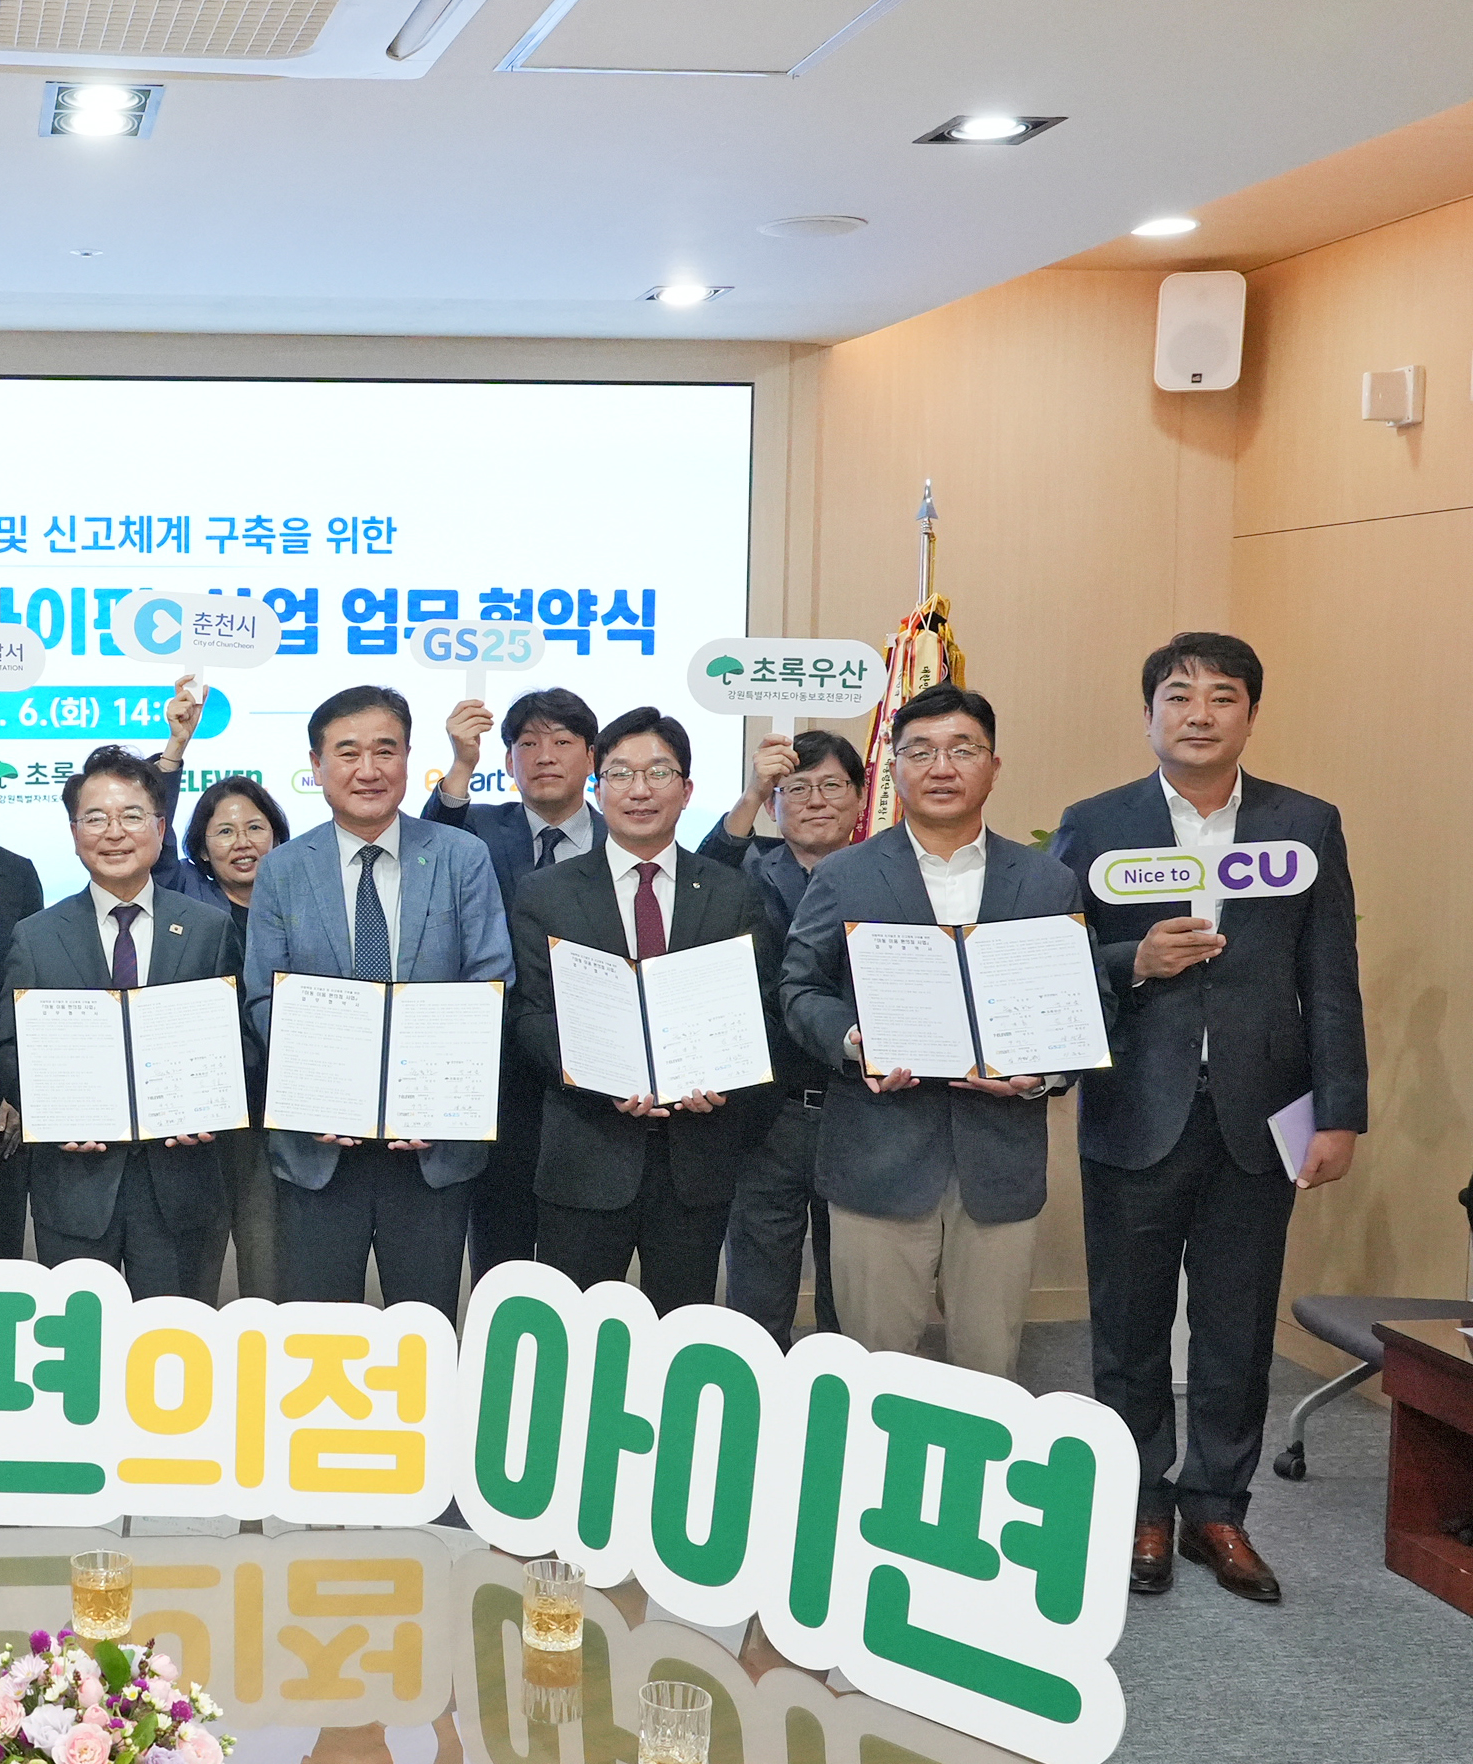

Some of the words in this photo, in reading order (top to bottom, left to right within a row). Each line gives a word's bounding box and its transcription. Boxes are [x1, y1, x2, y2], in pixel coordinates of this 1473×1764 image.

[43, 514, 192, 555] 신고체계
[205, 514, 312, 556] 구축을
[326, 515, 398, 556] 위한
[193, 612, 256, 639] 춘천시
[192, 639, 206, 648] City
[216, 641, 255, 649] ChunCheon
[423, 627, 532, 663] GS25
[750, 657, 868, 689] 초록우산
[18, 696, 100, 728] 6.(화)
[727, 690, 863, 703] 강원특별자치도아동보호전문기관
[1124, 869, 1165, 884] Nice
[1170, 867, 1191, 882] to
[1217, 850, 1298, 890] CU
[474, 1296, 1097, 1724] 아이편
